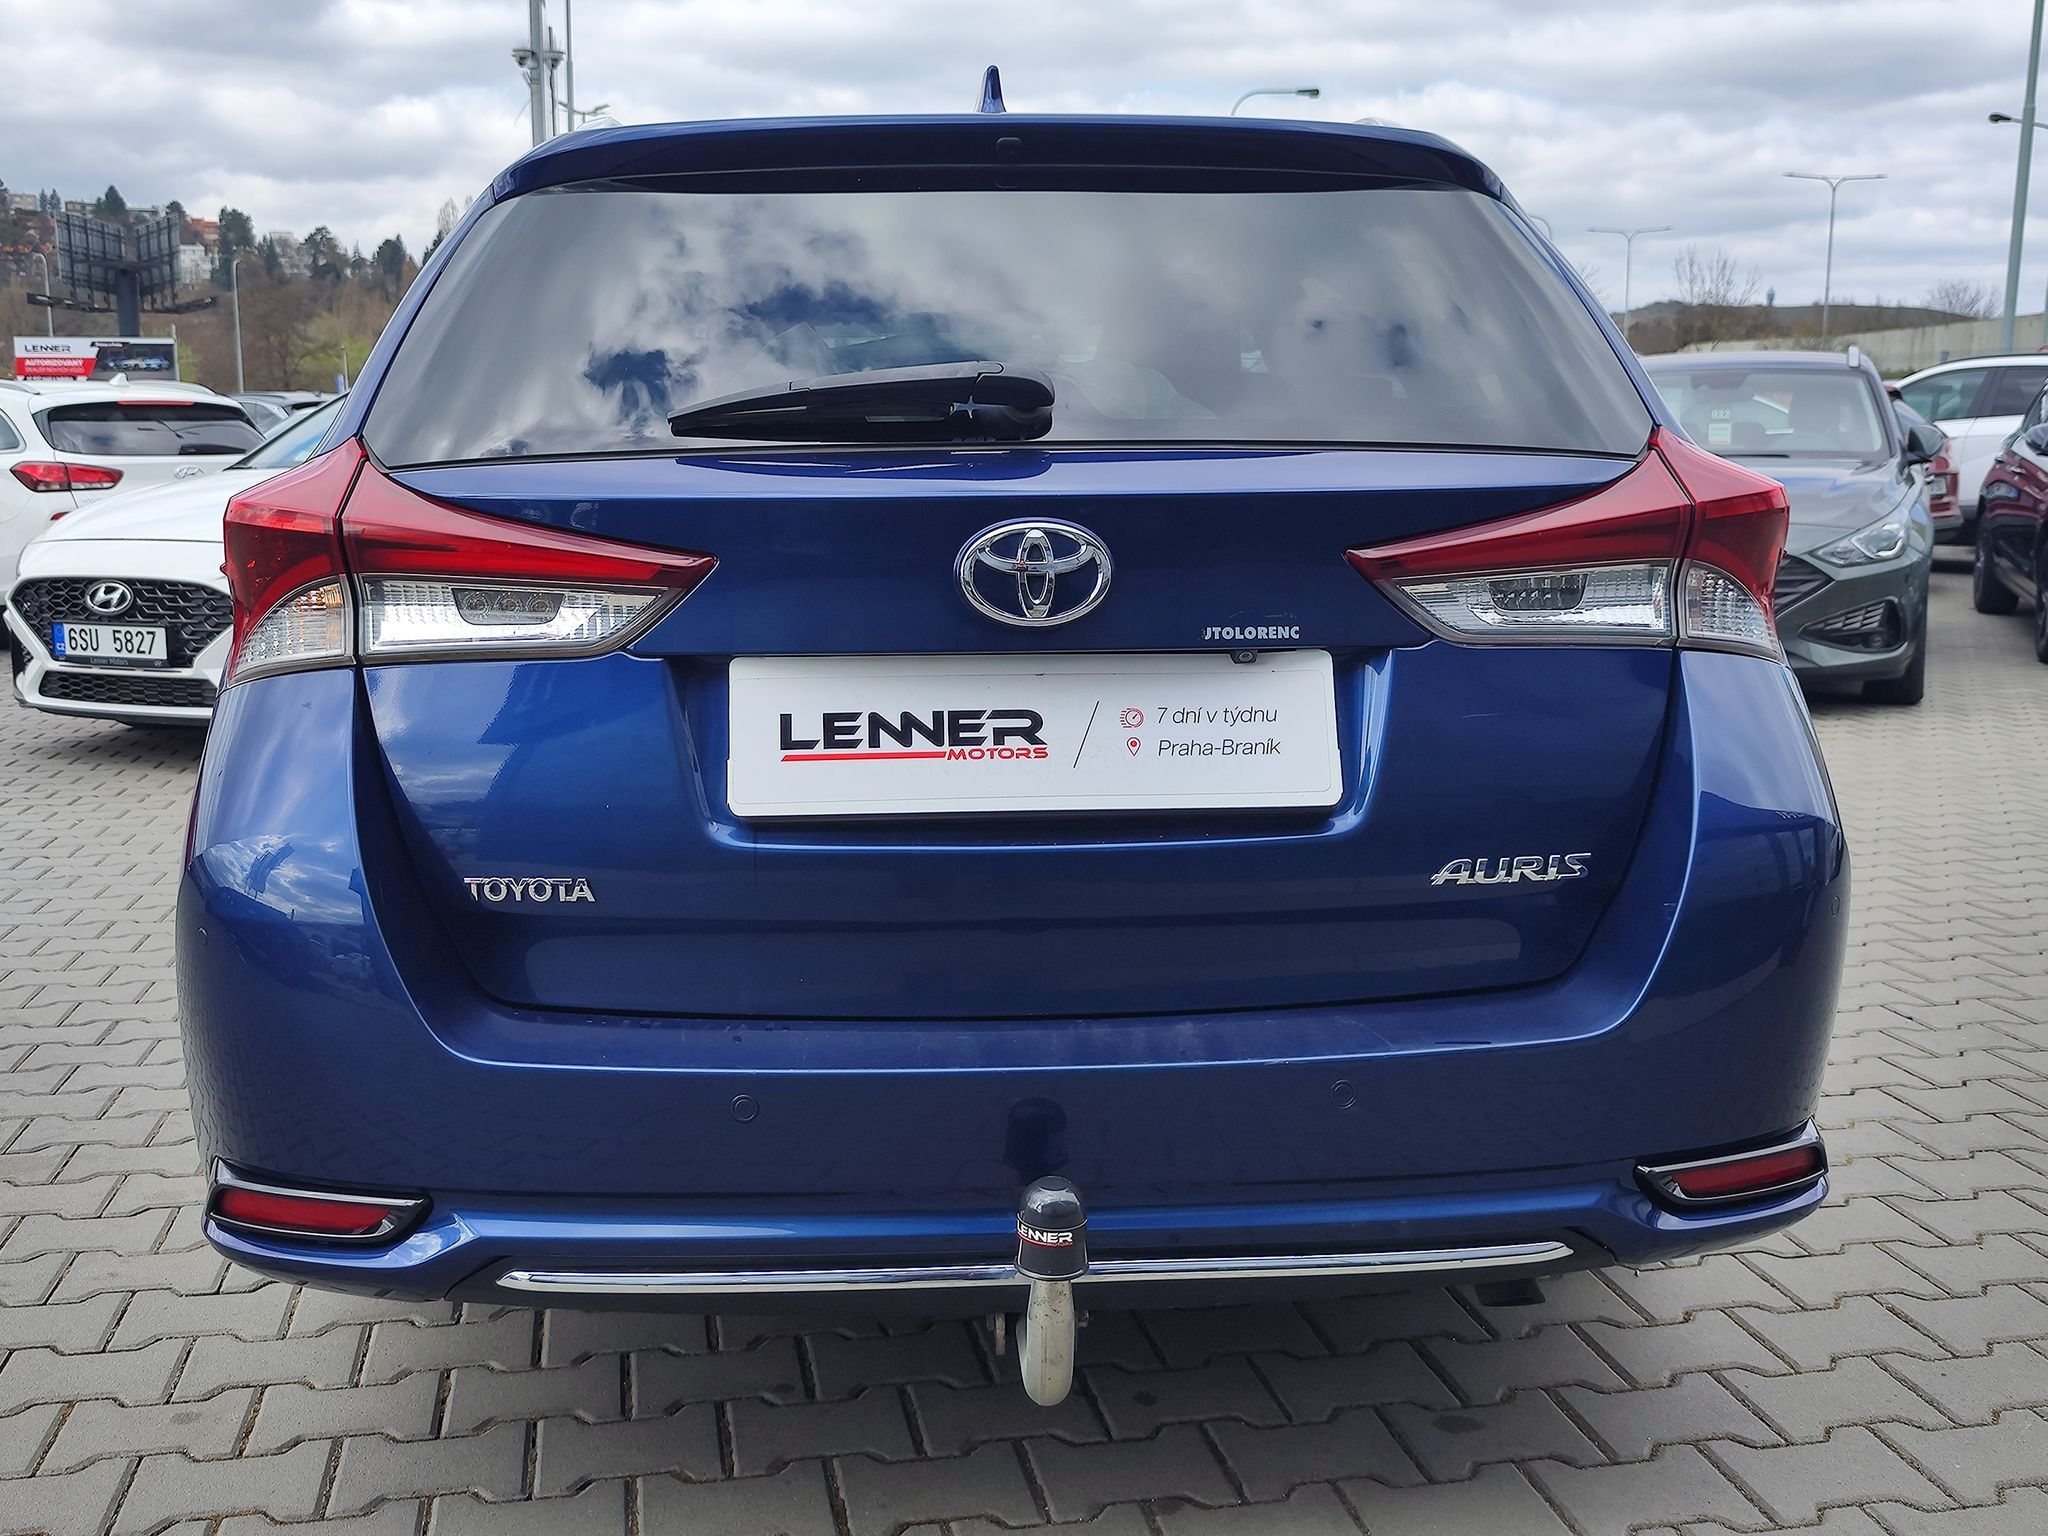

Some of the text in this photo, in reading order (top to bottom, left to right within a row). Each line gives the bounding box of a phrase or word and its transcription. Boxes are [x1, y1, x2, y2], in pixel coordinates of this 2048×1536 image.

[24, 344, 72, 353] LENNER
[68, 628, 156, 654] 6SU 5827
[109, 658, 129, 666] Motors
[1157, 706, 1278, 727] 7 dní v týdnu
[780, 709, 1048, 750] LENNER
[947, 747, 1049, 761] MOTORS
[1158, 738, 1281, 756] Praha-Braník
[1430, 853, 1592, 886] AURIS
[464, 877, 595, 902] TOYOTA
